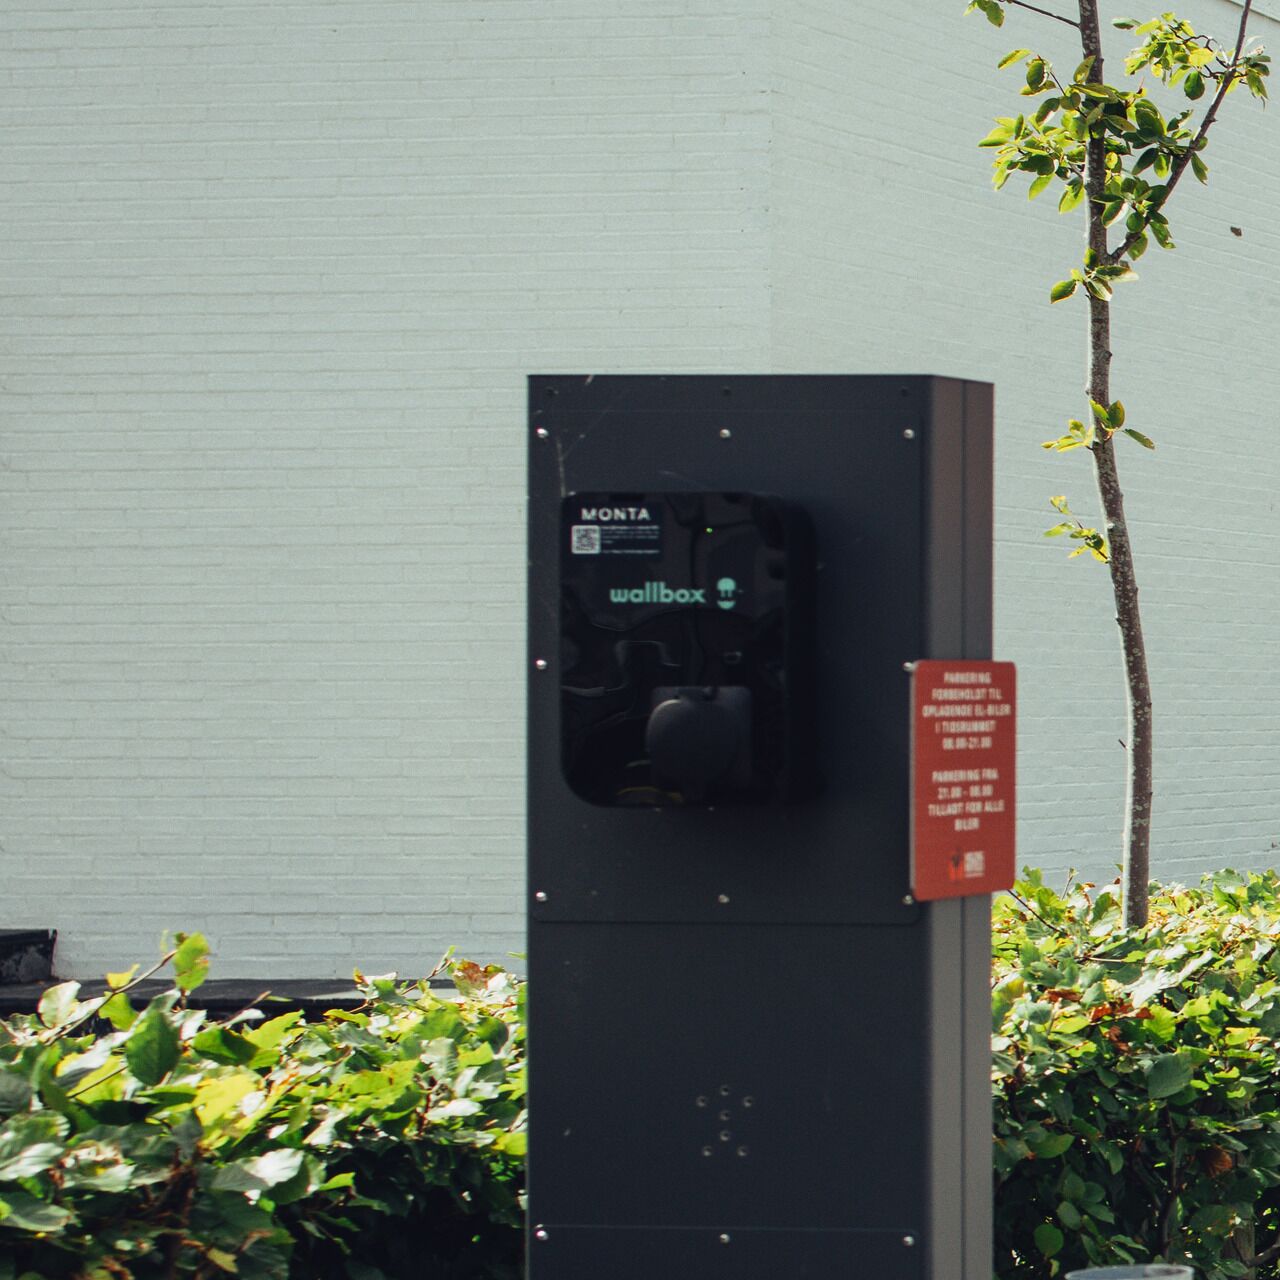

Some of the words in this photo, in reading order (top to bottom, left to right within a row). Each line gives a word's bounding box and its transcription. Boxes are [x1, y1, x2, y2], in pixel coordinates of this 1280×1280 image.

[581, 507, 650, 521] MONTA
[609, 581, 706, 603] wallbox
[944, 672, 993, 684] PARKERING
[988, 688, 1003, 700] TIL
[932, 769, 980, 783] PARKERING
[982, 768, 998, 780] FRA
[928, 802, 964, 817] TILLADT
[965, 801, 983, 814] FOR
[984, 799, 1005, 813] ALLE
[954, 817, 980, 831] BILER
